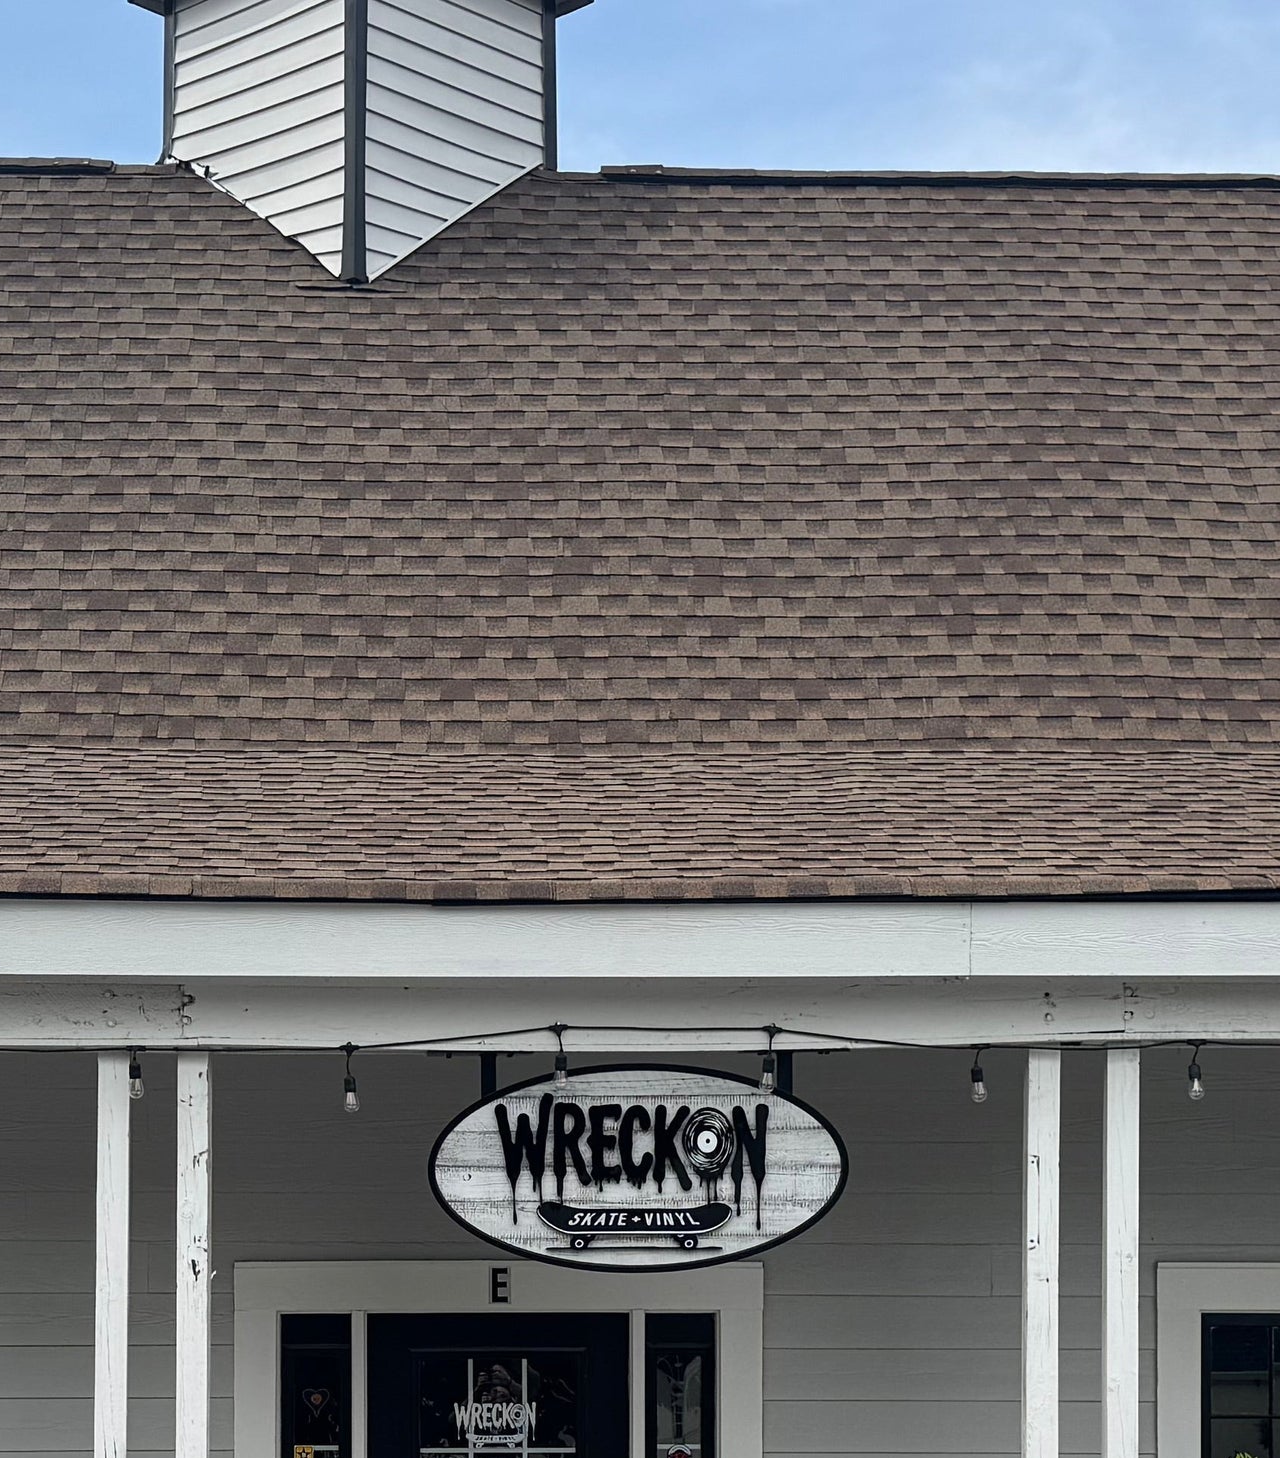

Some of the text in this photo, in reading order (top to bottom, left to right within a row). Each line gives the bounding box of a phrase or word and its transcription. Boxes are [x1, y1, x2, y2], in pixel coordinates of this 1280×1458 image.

[495, 1093, 769, 1229] WRECKON
[568, 1212, 628, 1227] SKATE
[644, 1212, 700, 1227] VINYL
[492, 1269, 509, 1302] E
[453, 1401, 537, 1438] WRECKON
